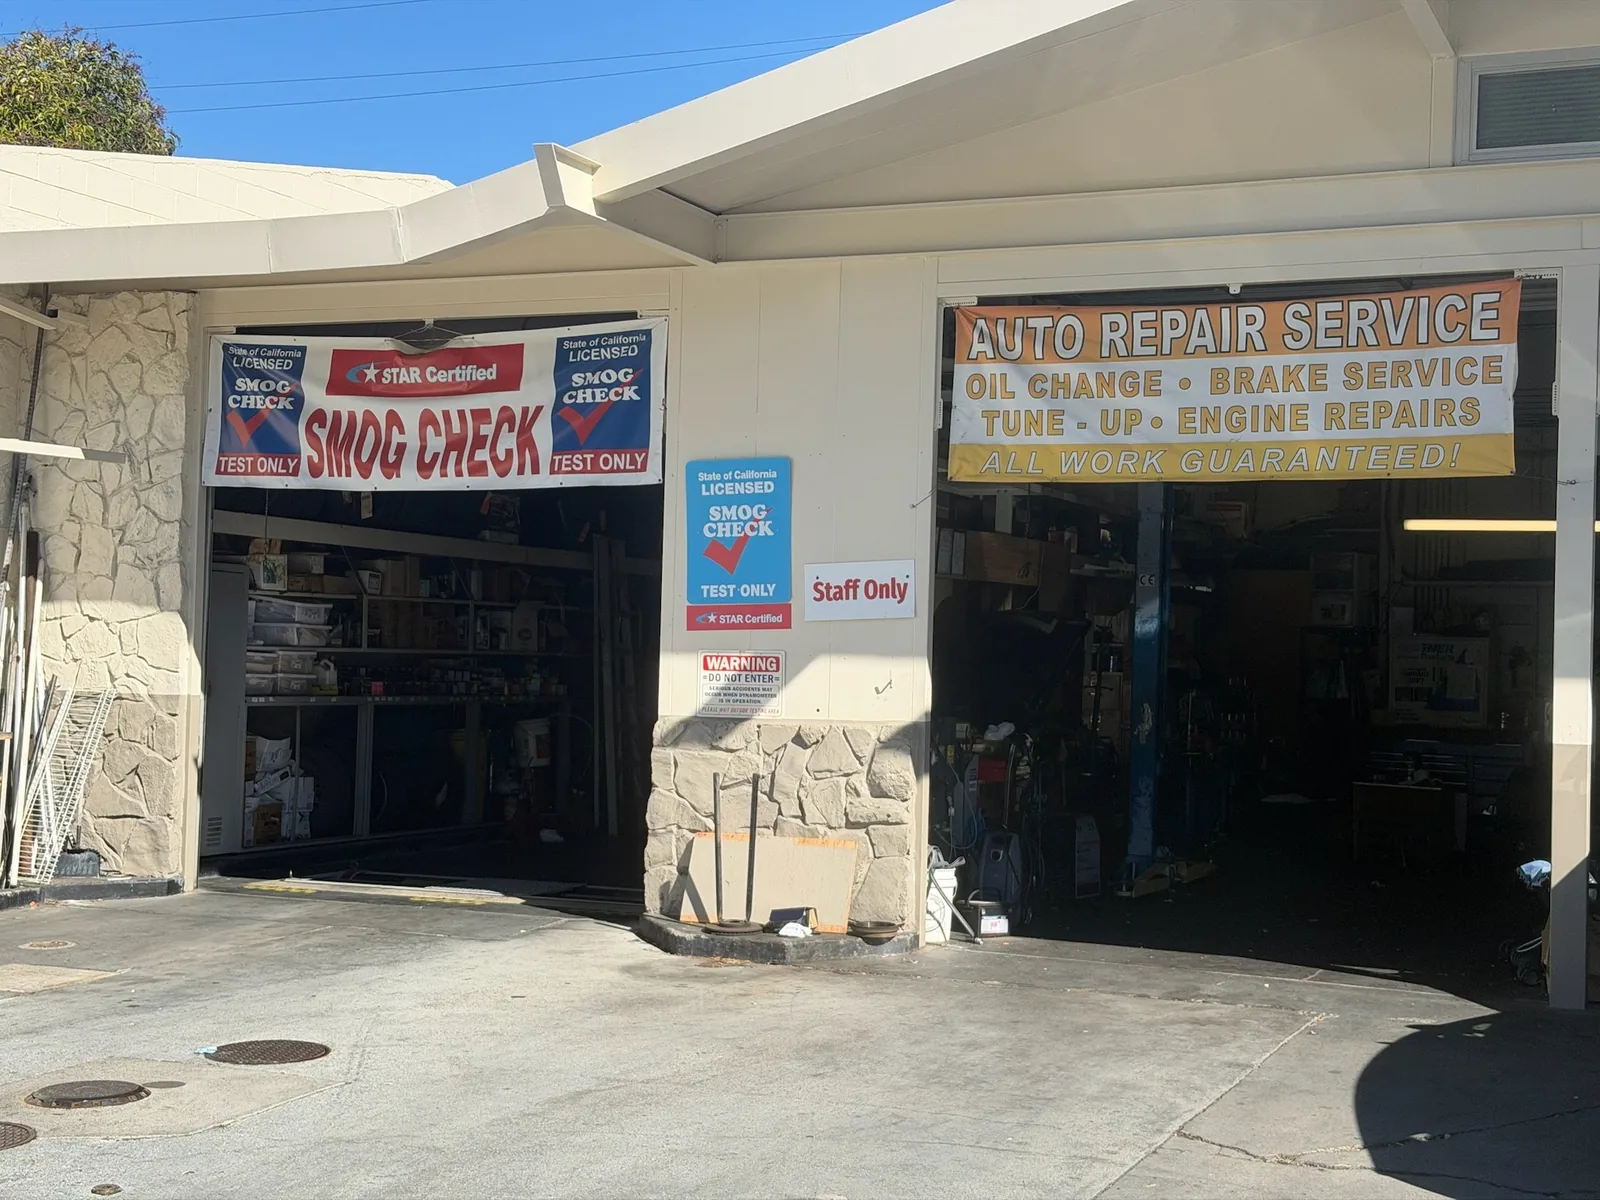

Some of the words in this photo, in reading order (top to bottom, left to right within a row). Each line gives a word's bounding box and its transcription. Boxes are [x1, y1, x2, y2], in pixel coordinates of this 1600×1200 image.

[967, 314, 1085, 361] AUTO
[1099, 304, 1267, 358] REPAIR
[1282, 291, 1502, 350] SERVICE
[563, 340, 586, 349] State
[589, 338, 599, 347] of
[601, 334, 646, 346] California
[228, 346, 248, 355] State
[249, 347, 259, 355] of
[260, 348, 302, 357] California
[569, 345, 639, 362] LICENSED
[233, 356, 293, 370] LICENSED
[382, 366, 422, 384] STAR
[425, 364, 497, 383] Certified
[571, 367, 634, 387] SMOG
[966, 373, 1016, 400] OIL
[1028, 370, 1162, 399] CHANGE
[1210, 363, 1328, 395] BRAKE
[1343, 355, 1503, 391] SERVICE
[235, 377, 292, 394] SMOG
[228, 394, 295, 410] CHECK
[563, 385, 641, 404] CHECK
[981, 409, 1065, 437] TUNE
[1100, 408, 1142, 435] UP
[1178, 404, 1309, 435] ENGINE
[1324, 396, 1481, 431] REPAIRS
[305, 408, 408, 480] SMOG
[416, 405, 545, 480] CHECK
[220, 457, 254, 473] TEST
[257, 457, 299, 474] ONLY
[553, 453, 594, 471] TEST
[599, 452, 647, 471] ONLY
[979, 450, 1044, 474] ALL
[1060, 450, 1167, 474] WORK
[1180, 442, 1461, 474] GUARANTEED!
[698, 472, 721, 481] State
[723, 471, 732, 480] of
[734, 469, 777, 480] California
[701, 481, 774, 496] LICENSED
[709, 504, 767, 521] SMOG
[703, 520, 774, 538] CHECK
[700, 584, 736, 598] TEST
[740, 583, 776, 597] ONLY
[813, 578, 861, 602] Staff
[864, 577, 908, 604] Only
[719, 614, 743, 624] STAR
[745, 613, 782, 624] Certified
[706, 656, 777, 671] WARNING
[709, 673, 721, 682] DO
[724, 673, 743, 683] NOT
[745, 674, 774, 684] ENTER
